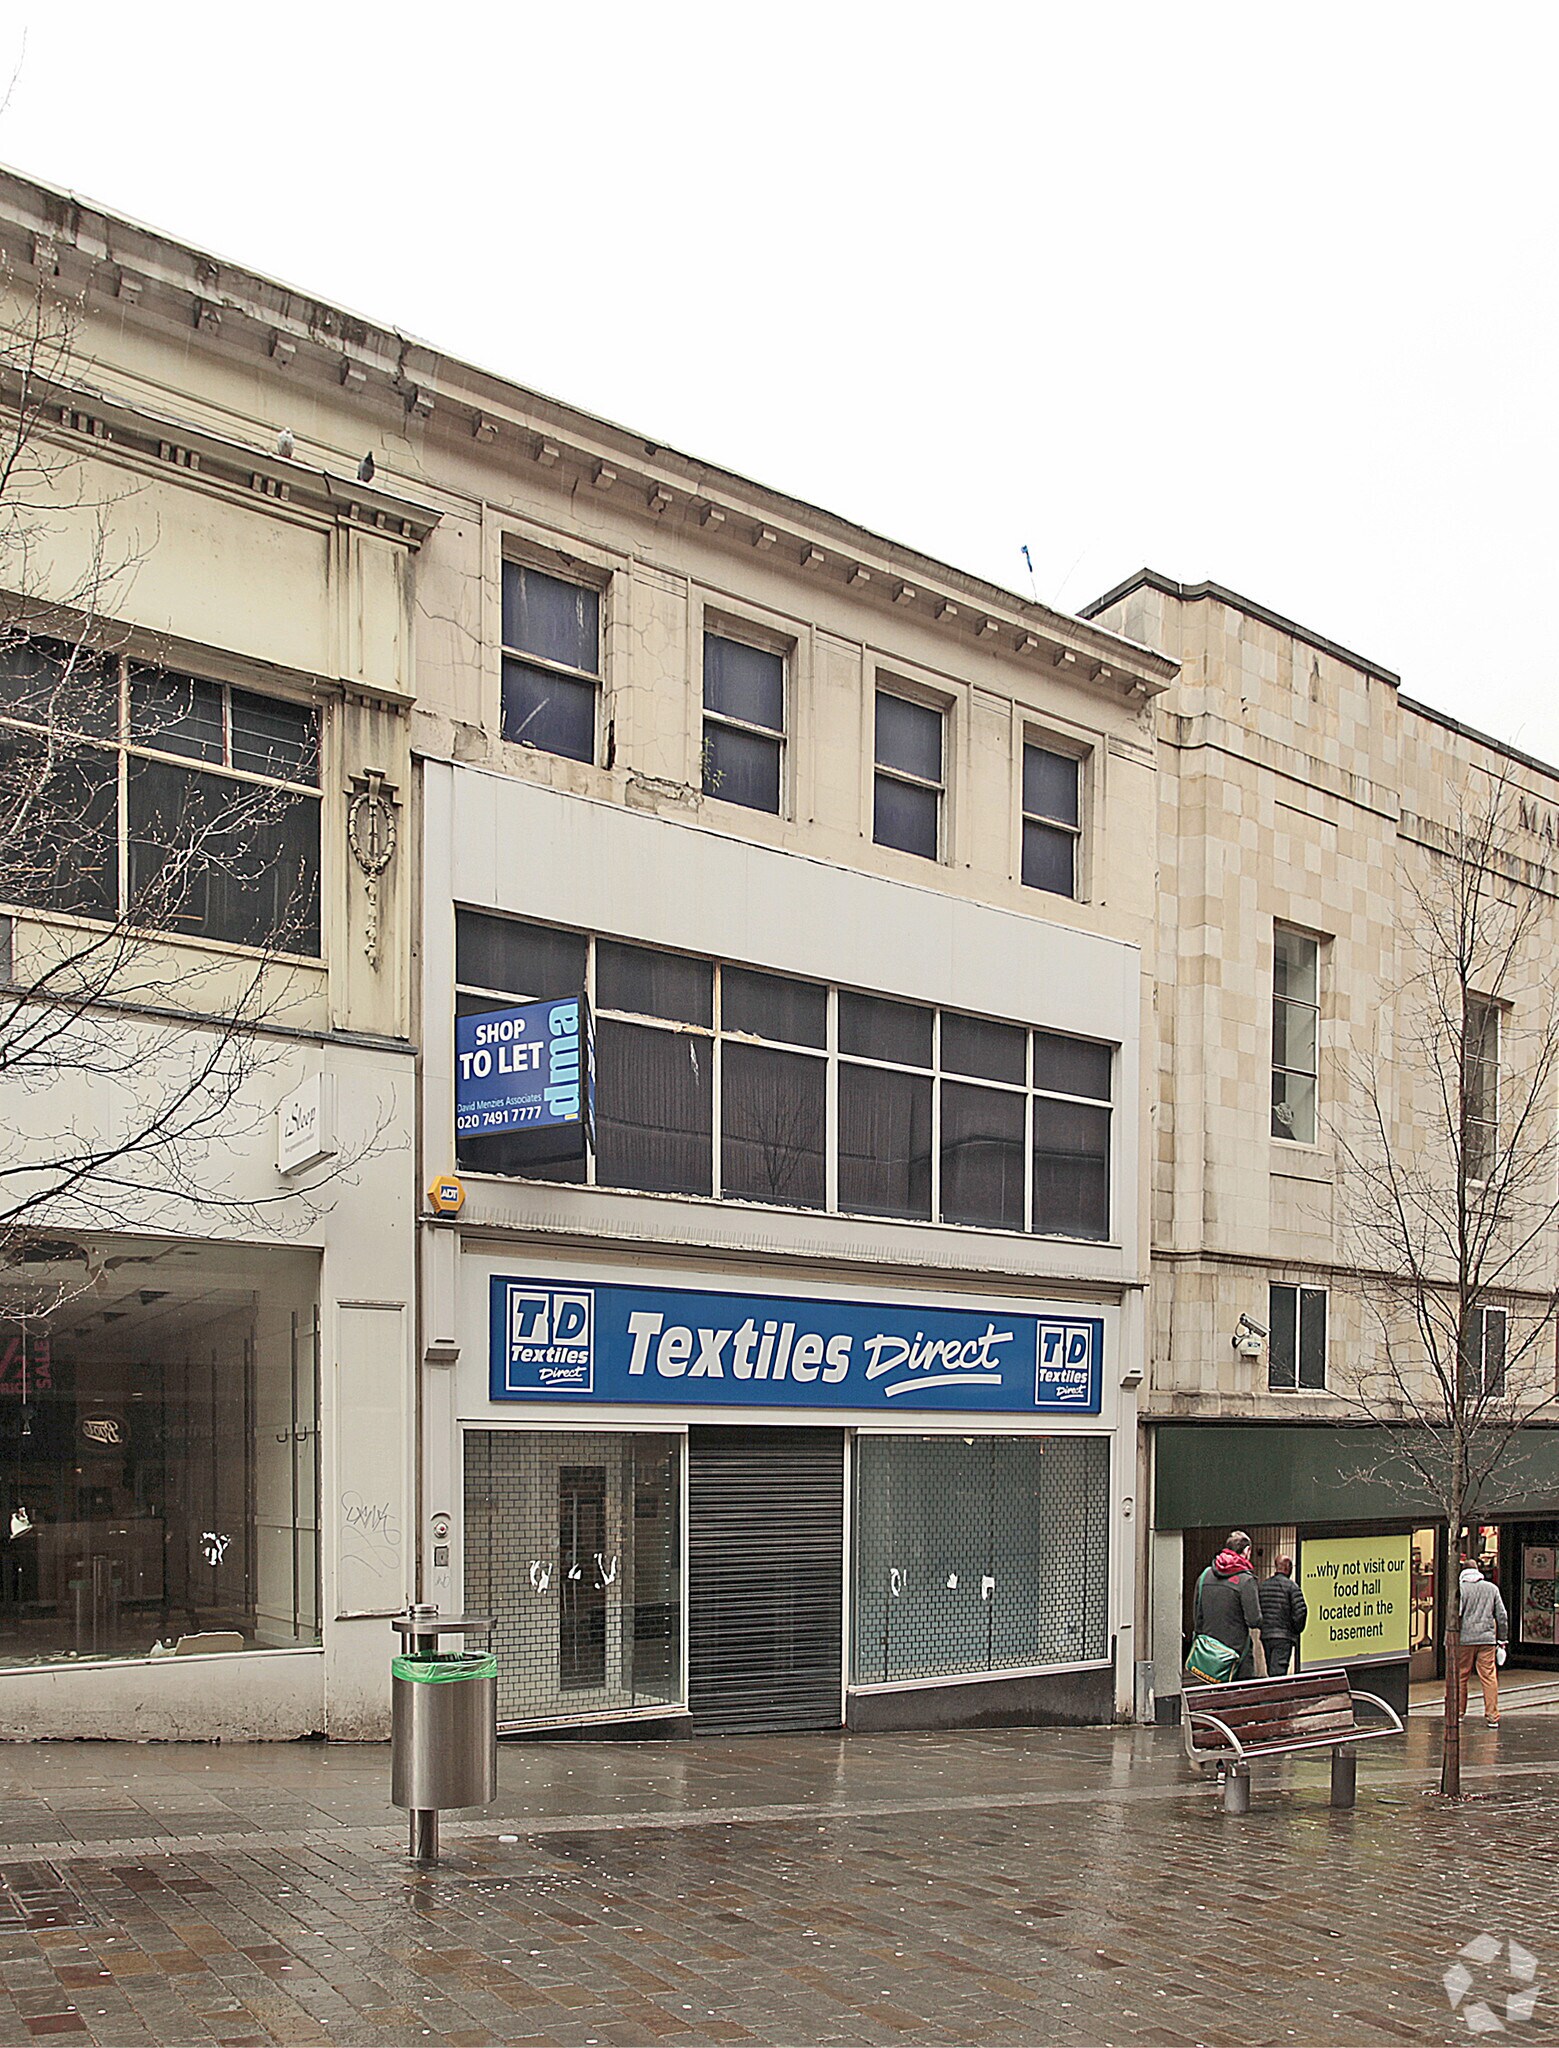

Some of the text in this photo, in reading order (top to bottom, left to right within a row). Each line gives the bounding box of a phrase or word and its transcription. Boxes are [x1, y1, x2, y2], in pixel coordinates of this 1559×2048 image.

[475, 1018, 526, 1046] SHOP
[459, 1041, 544, 1080] TO LET
[544, 1003, 579, 1117] dma
[457, 1093, 542, 1113] David Menzies Associates
[457, 1106, 542, 1129] 020 7491 7777
[441, 1186, 459, 1200] ADT
[511, 1345, 589, 1364] Textiles
[627, 1311, 1014, 1384] Textiles Direct
[34, 1340, 52, 1389] SALE
[538, 1366, 588, 1381] Direct
[1039, 1368, 1088, 1384] Textiles
[1056, 1385, 1087, 1397] Direct
[1342, 1560, 1361, 1575] not
[1363, 1557, 1385, 1574] visit
[1387, 1560, 1405, 1572] our
[1334, 1579, 1381, 1597] food hall
[1319, 1600, 1393, 1621] located in the
[1329, 1621, 1383, 1641] basement
